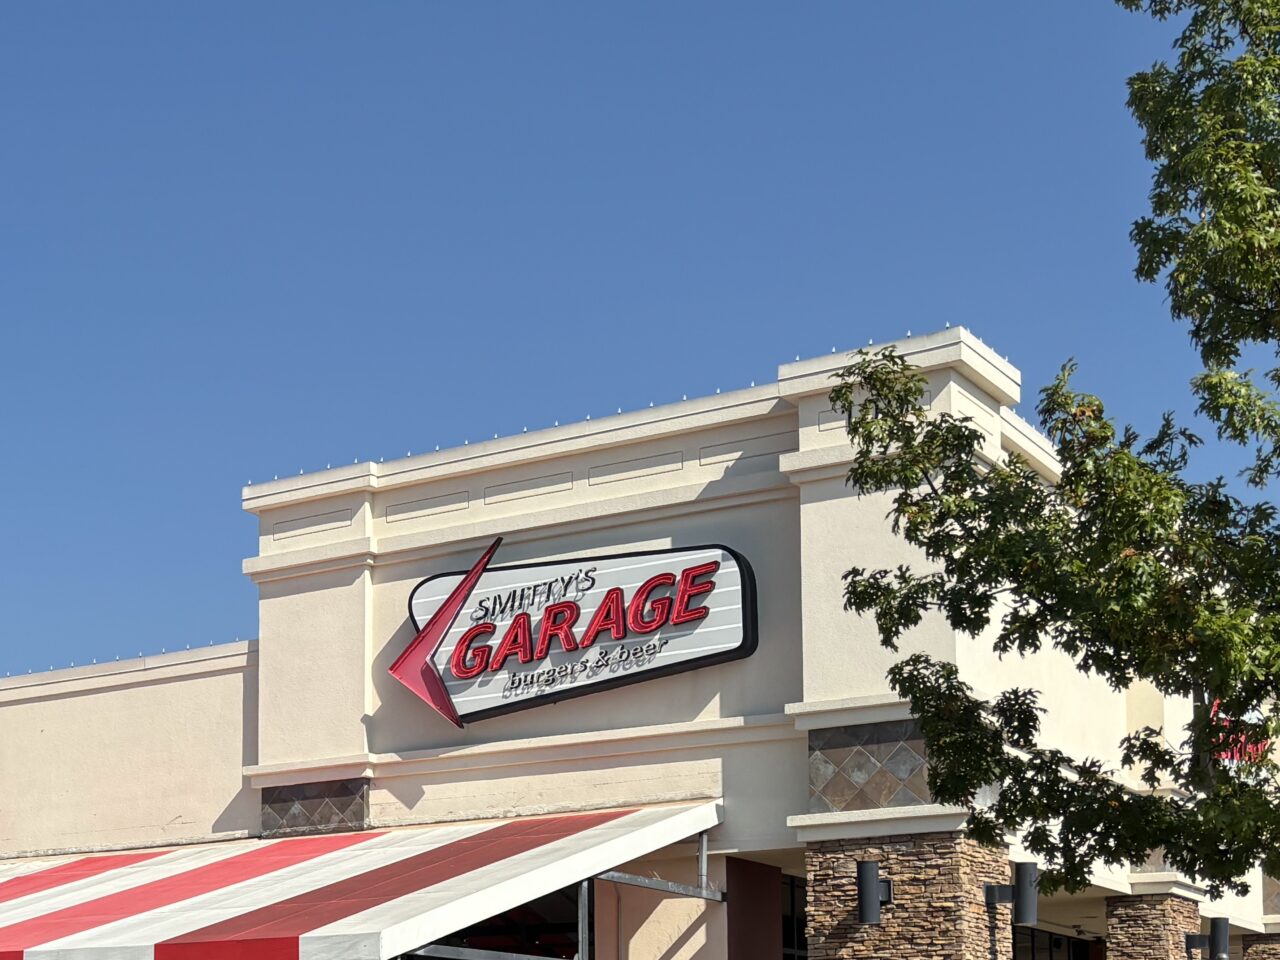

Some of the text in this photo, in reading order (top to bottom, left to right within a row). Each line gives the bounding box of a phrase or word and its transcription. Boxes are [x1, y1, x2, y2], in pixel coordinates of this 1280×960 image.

[451, 560, 720, 680] GARAGE
[470, 567, 597, 621] SMITTY'S
[510, 639, 669, 689] burgers & beer
